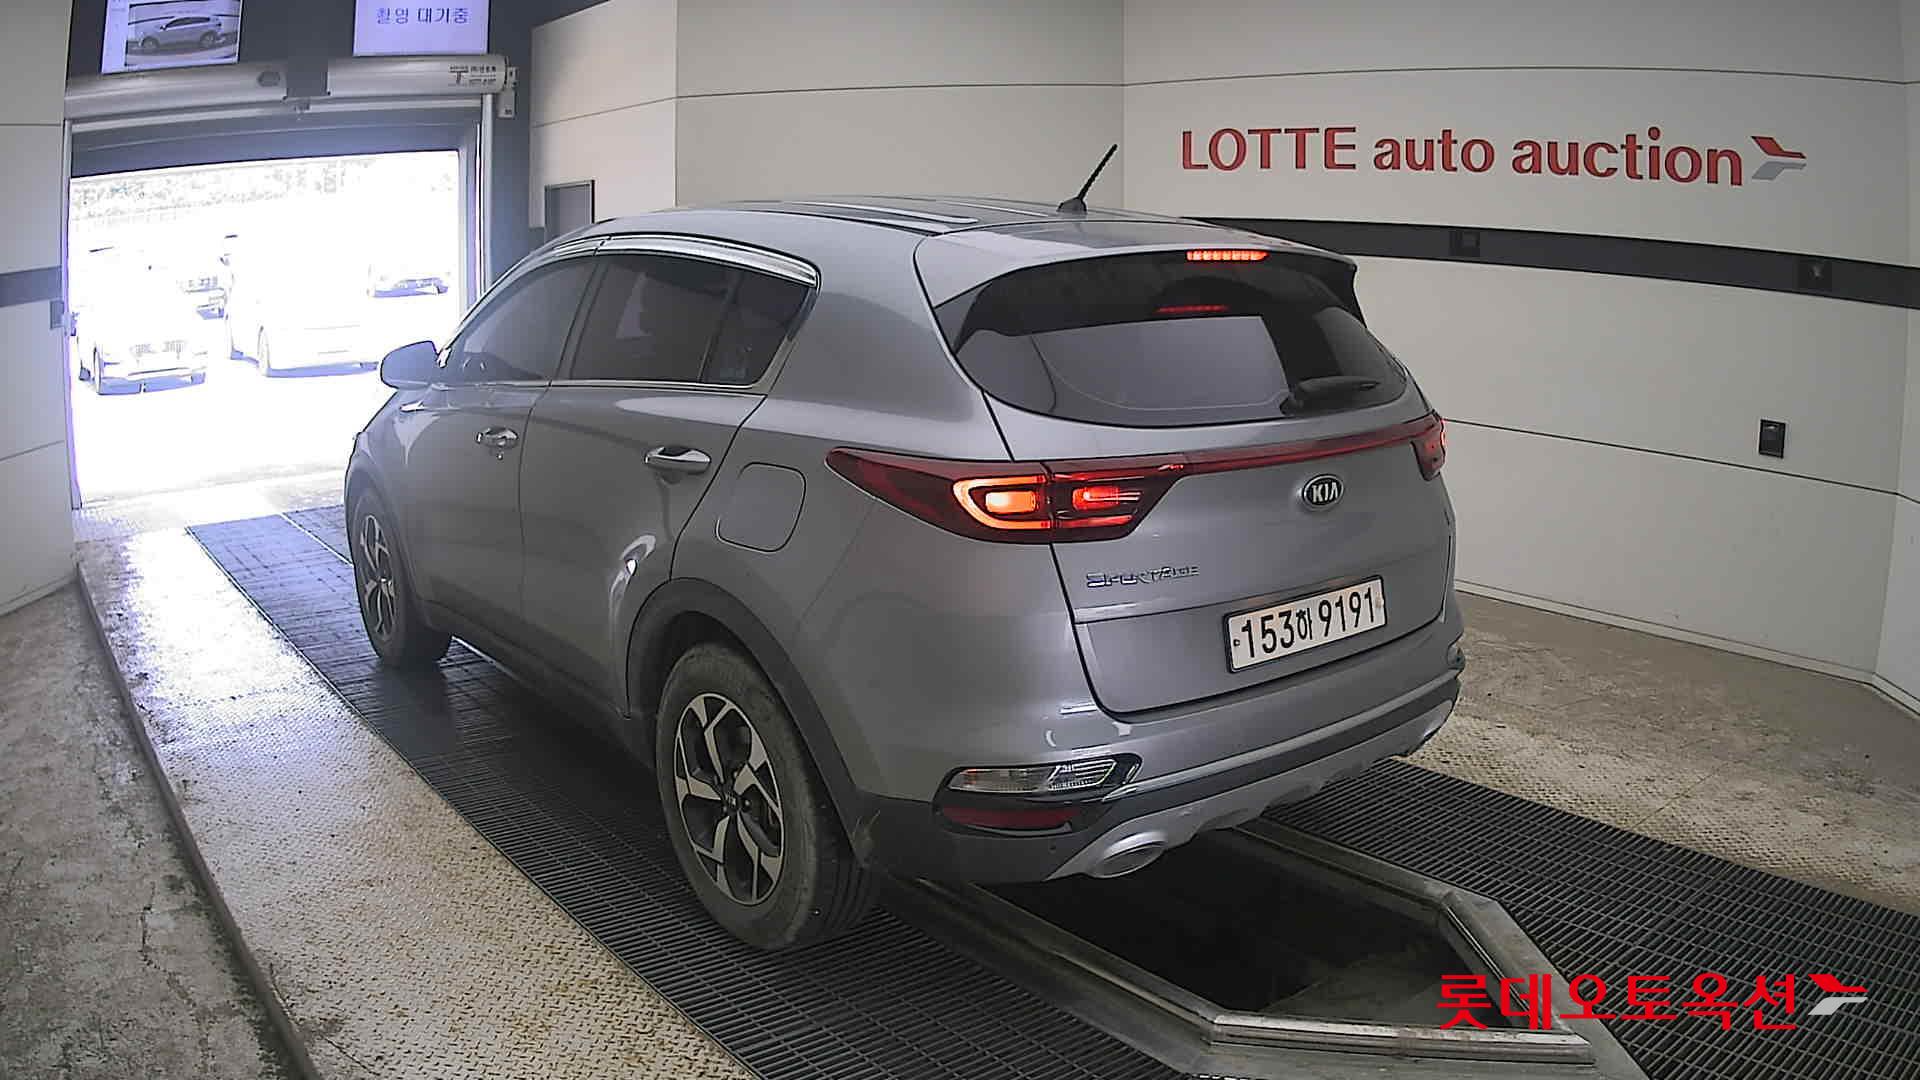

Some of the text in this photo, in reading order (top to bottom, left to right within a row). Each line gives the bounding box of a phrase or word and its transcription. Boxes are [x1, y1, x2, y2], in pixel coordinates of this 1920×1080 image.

[417, 7, 469, 24] 대기중
[1182, 126, 1743, 187] LOTTE auto auction
[1311, 482, 1339, 503] KIA
